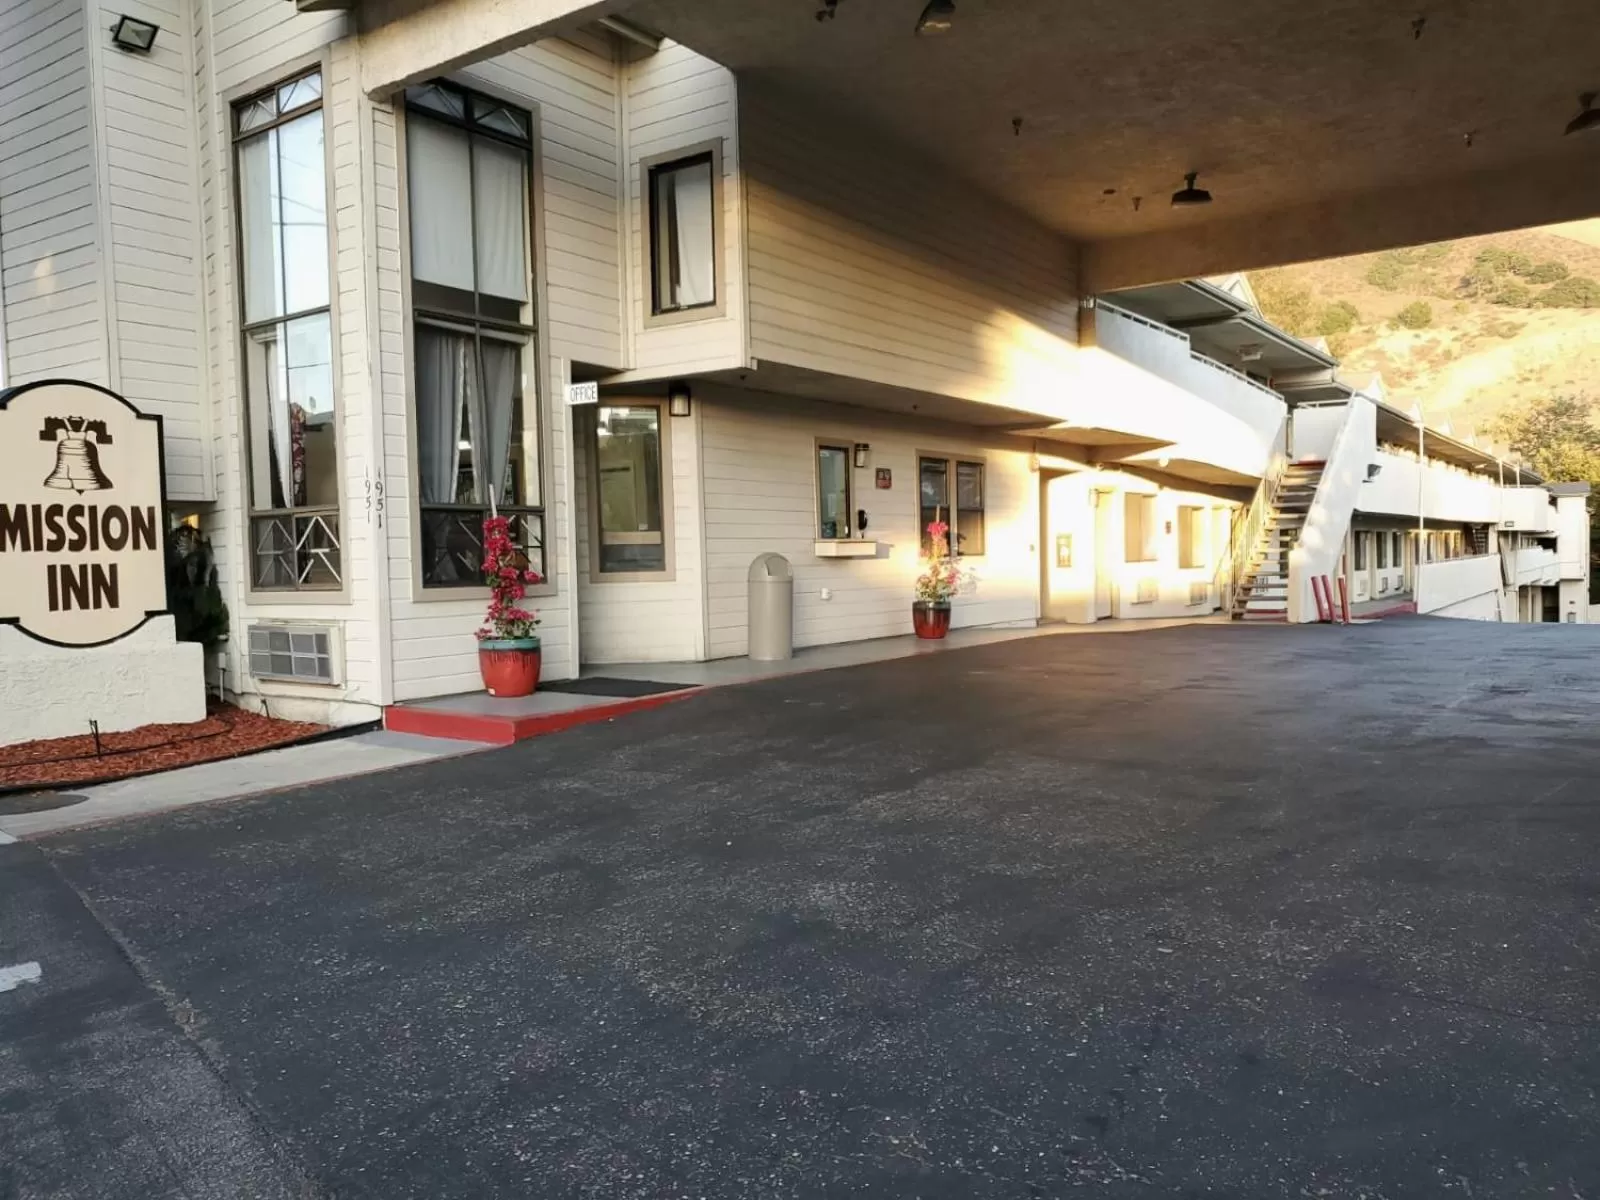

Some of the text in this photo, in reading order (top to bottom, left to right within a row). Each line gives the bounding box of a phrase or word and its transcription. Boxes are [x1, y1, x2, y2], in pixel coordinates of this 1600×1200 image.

[571, 384, 596, 402] OFFICE
[375, 466, 384, 529] 1951
[0, 503, 157, 552] MISSION
[47, 563, 119, 612] INN
